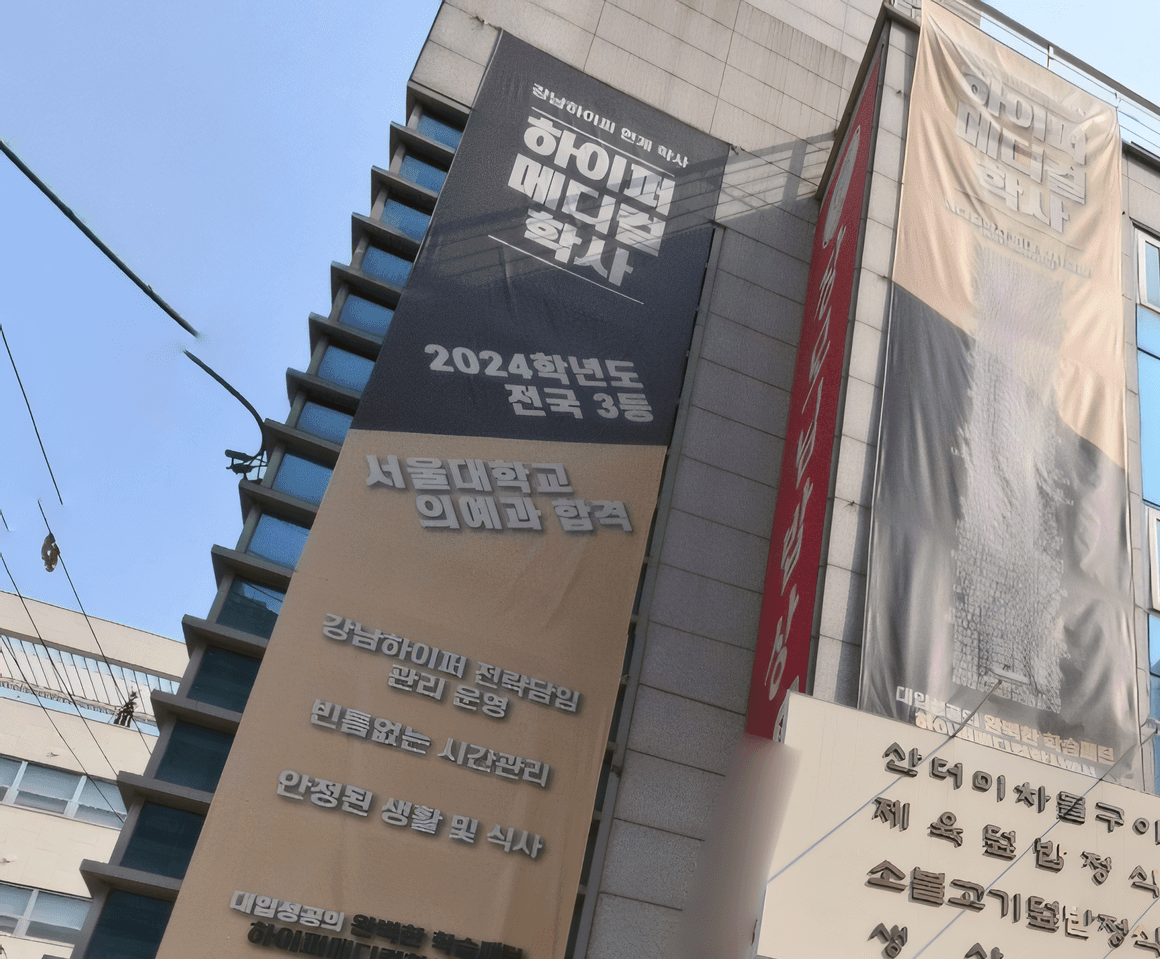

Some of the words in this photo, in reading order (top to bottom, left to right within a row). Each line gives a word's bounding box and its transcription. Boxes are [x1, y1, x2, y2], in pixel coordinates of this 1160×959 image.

[523, 115, 676, 216] 하이퍼
[507, 152, 666, 257] 메디컬
[524, 208, 633, 287] 학사
[424, 344, 644, 389] 2024학년도
[504, 384, 583, 419] 전국
[597, 394, 654, 423] 3등
[365, 454, 574, 493] 서울대학교
[415, 494, 542, 530] 의예과
[551, 497, 633, 532] 합격
[321, 613, 467, 678] 강남하이퍼
[475, 661, 580, 713] 전략담임
[388, 664, 446, 700] 관리
[453, 684, 509, 718] 운영
[437, 737, 550, 787] 시간관리
[276, 769, 374, 817] 안정된
[381, 797, 443, 834] 생활
[449, 814, 479, 843] 및
[487, 823, 545, 859] 식사
